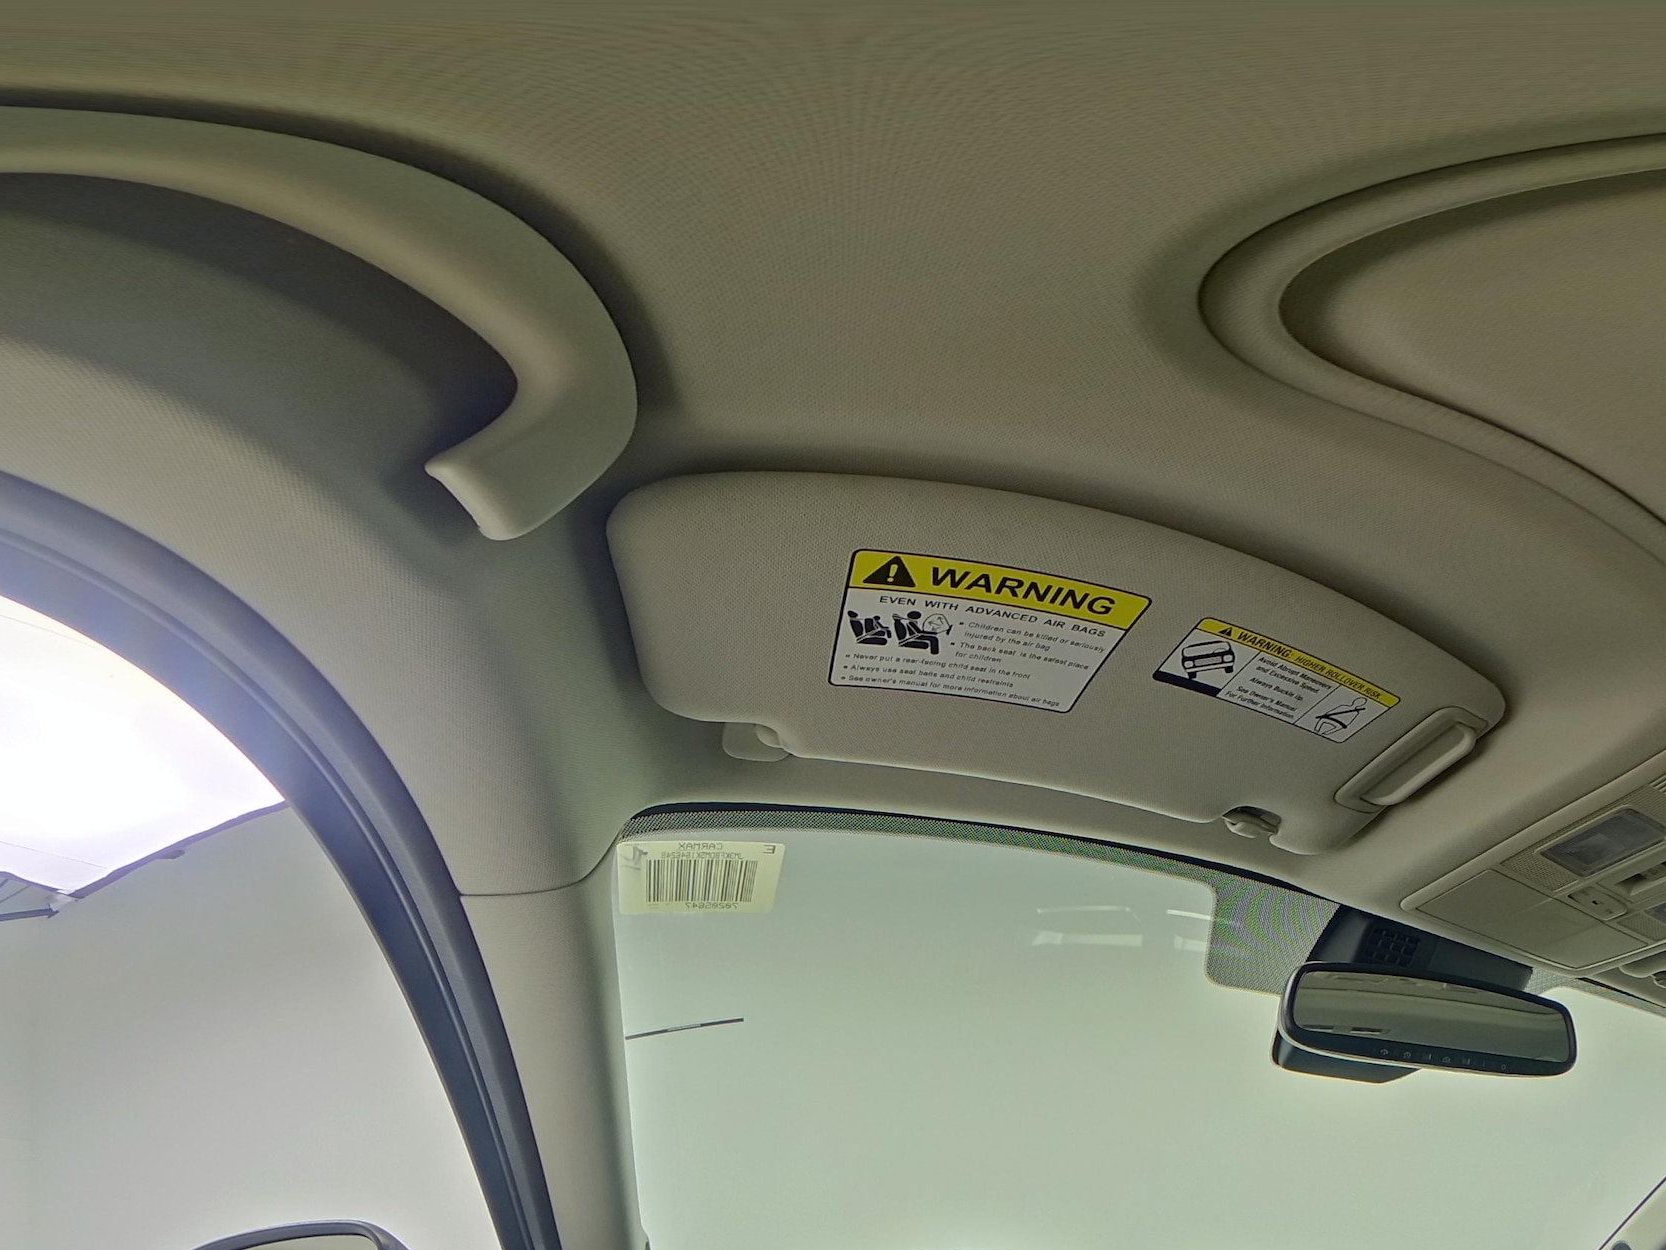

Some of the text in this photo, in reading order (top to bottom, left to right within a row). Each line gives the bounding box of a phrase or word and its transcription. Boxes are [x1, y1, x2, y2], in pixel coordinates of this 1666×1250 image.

[932, 566, 1116, 615] WARNING
[879, 595, 1107, 638] EVEN WITH ADVANCED AIR BAGS
[963, 631, 1051, 652] injured by the air bag
[968, 621, 1004, 633] Children
[1006, 627, 1022, 636] can
[1023, 630, 1034, 638] be
[1036, 632, 1059, 643] killed
[1070, 639, 1106, 654] seriously
[879, 654, 893, 662] put
[902, 657, 947, 668] rear-facing
[948, 662, 968, 670] child
[998, 668, 1011, 676] the
[1012, 671, 1031, 680] front
[960, 641, 976, 650] The
[977, 644, 996, 653] back
[999, 647, 1016, 656] seat
[1028, 652, 1043, 661] the
[1043, 655, 1067, 666] safest
[1068, 660, 1089, 671] place
[969, 653, 1002, 663] children
[1237, 631, 1382, 699] WARNING: HIGHER ROLLOVER RISK
[1258, 656, 1278, 667] Avoid
[1277, 664, 1300, 676] Abrupt
[850, 665, 880, 673] Always
[899, 668, 916, 676] seat
[918, 670, 938, 678] belts
[939, 672, 955, 680] and
[956, 674, 976, 682] child
[978, 677, 1014, 688] restraints
[1256, 666, 1269, 674] and
[899, 679, 928, 687] manual
[964, 686, 1007, 698] information
[1008, 692, 1030, 701] about
[1042, 698, 1060, 707] bags
[1250, 677, 1273, 690] Always
